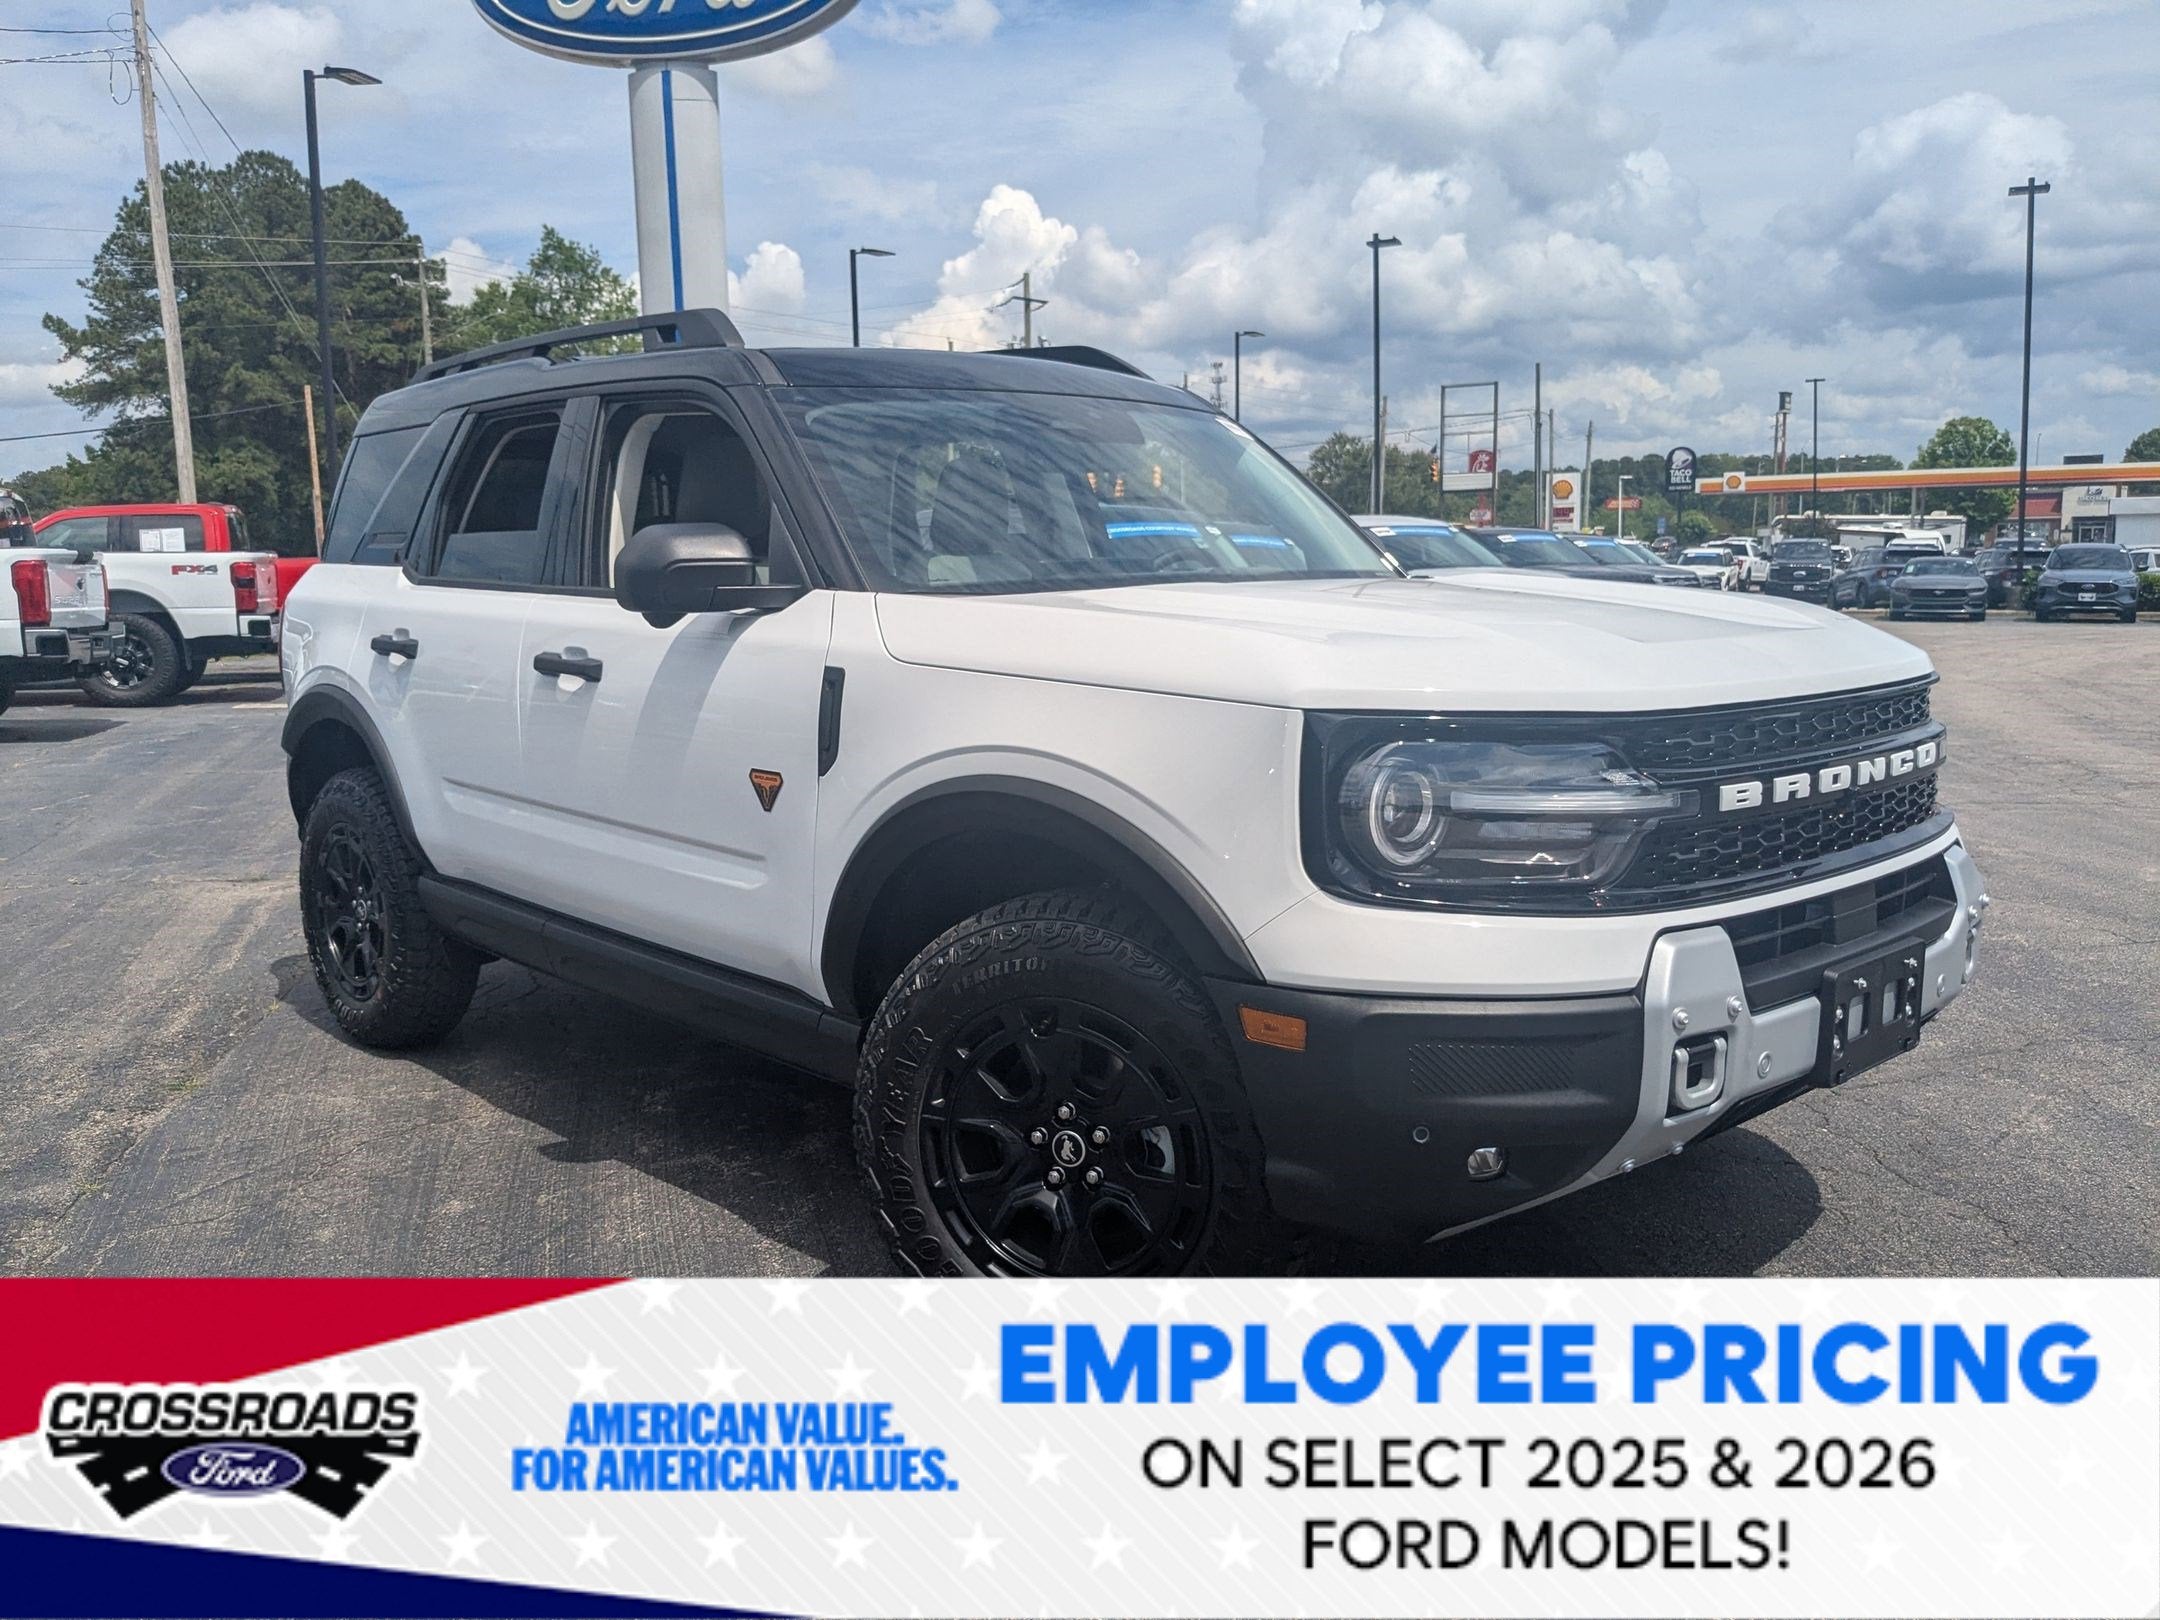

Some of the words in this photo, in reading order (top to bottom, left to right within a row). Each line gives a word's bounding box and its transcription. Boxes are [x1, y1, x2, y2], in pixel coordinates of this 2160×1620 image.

[1670, 469, 1692, 477] TACO
[1671, 476, 1691, 484] BELL
[1719, 742, 1937, 812] BRONCO
